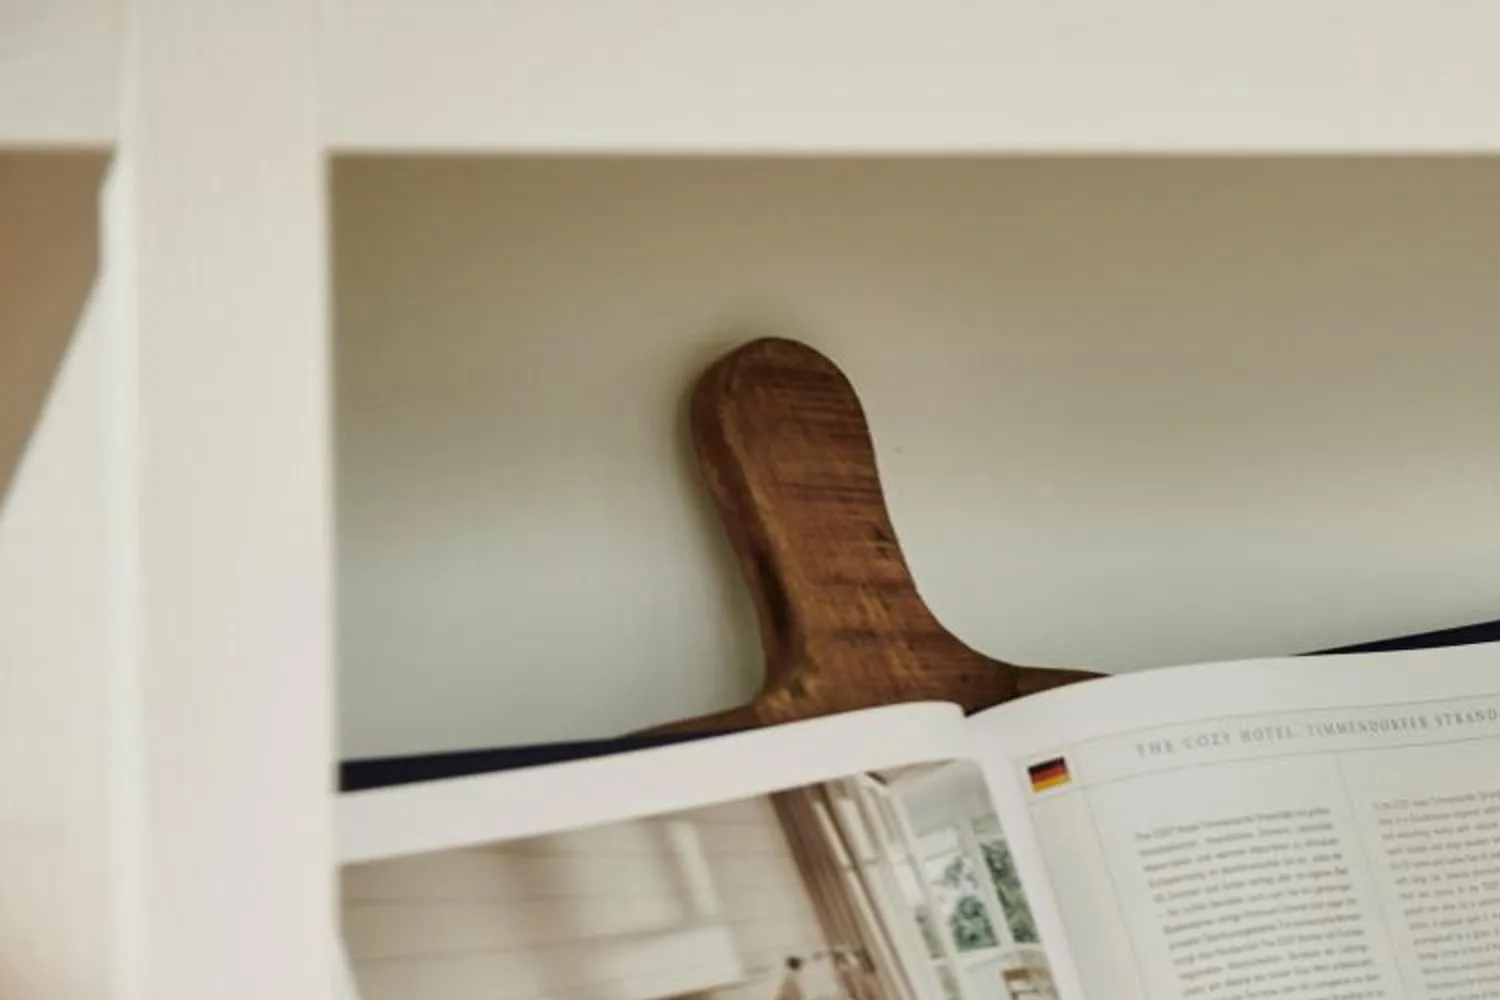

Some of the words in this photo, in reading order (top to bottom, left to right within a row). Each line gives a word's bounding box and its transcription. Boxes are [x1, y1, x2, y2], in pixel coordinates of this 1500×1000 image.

[1136, 739, 1175, 757] THE
[1181, 732, 1230, 750] COZY
[1240, 724, 1296, 744] HOTEL
[1434, 707, 1498, 729] STRAND
